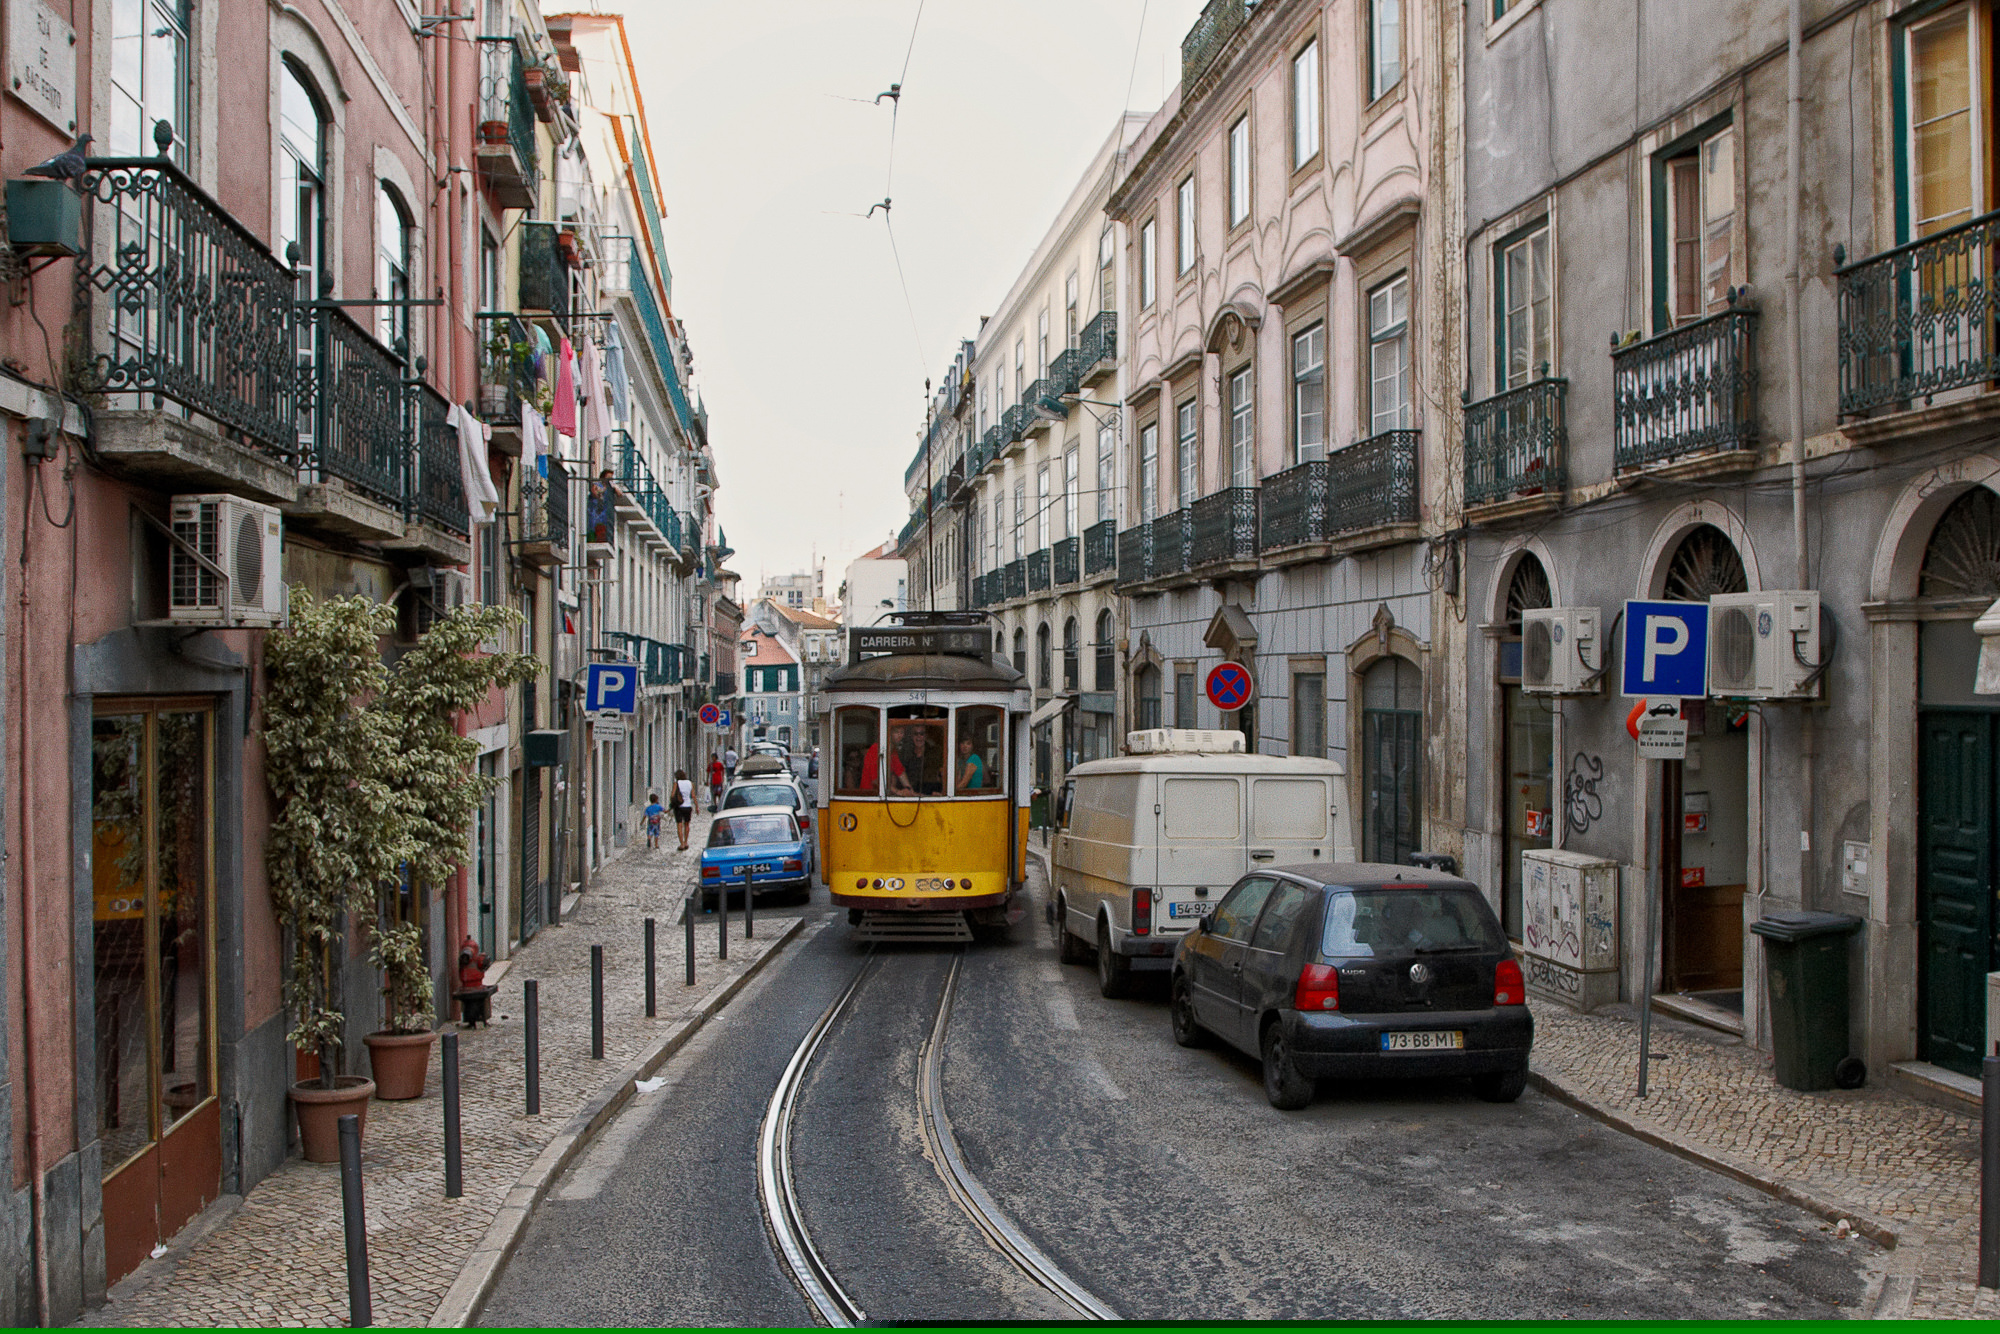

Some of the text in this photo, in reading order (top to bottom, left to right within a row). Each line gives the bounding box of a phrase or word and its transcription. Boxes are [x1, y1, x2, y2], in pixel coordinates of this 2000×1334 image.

[860, 635, 916, 648] CARREIRA
[949, 633, 974, 648] 28
[1642, 614, 1690, 683] P
[596, 670, 626, 706] P
[909, 692, 925, 701] 549
[718, 712, 727, 725] P
